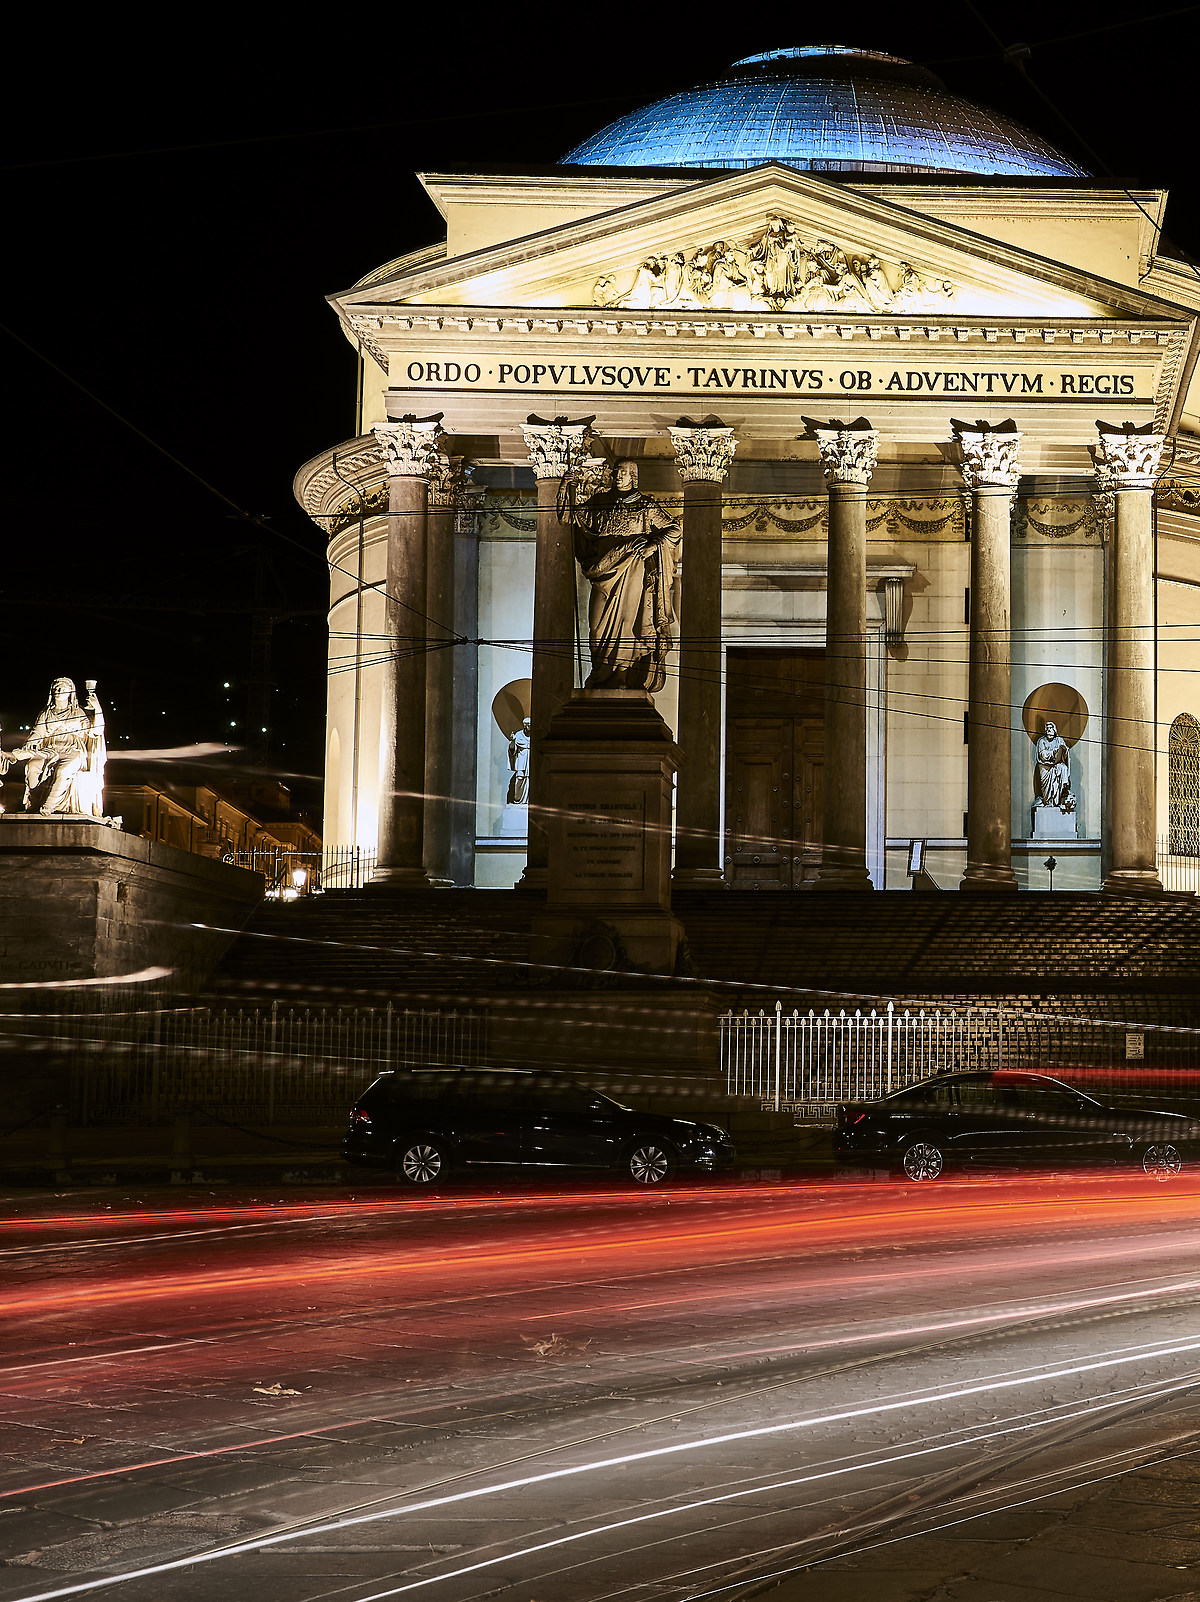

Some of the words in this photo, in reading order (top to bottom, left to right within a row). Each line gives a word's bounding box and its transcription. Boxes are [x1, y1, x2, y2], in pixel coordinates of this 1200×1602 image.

[407, 362, 481, 382] ORDO
[498, 363, 671, 388] POPVLVSQVE
[687, 368, 823, 389] TAVRINVS
[839, 371, 872, 390] OB
[885, 371, 1043, 393] ADVENTVM
[1060, 374, 1134, 395] REGIS
